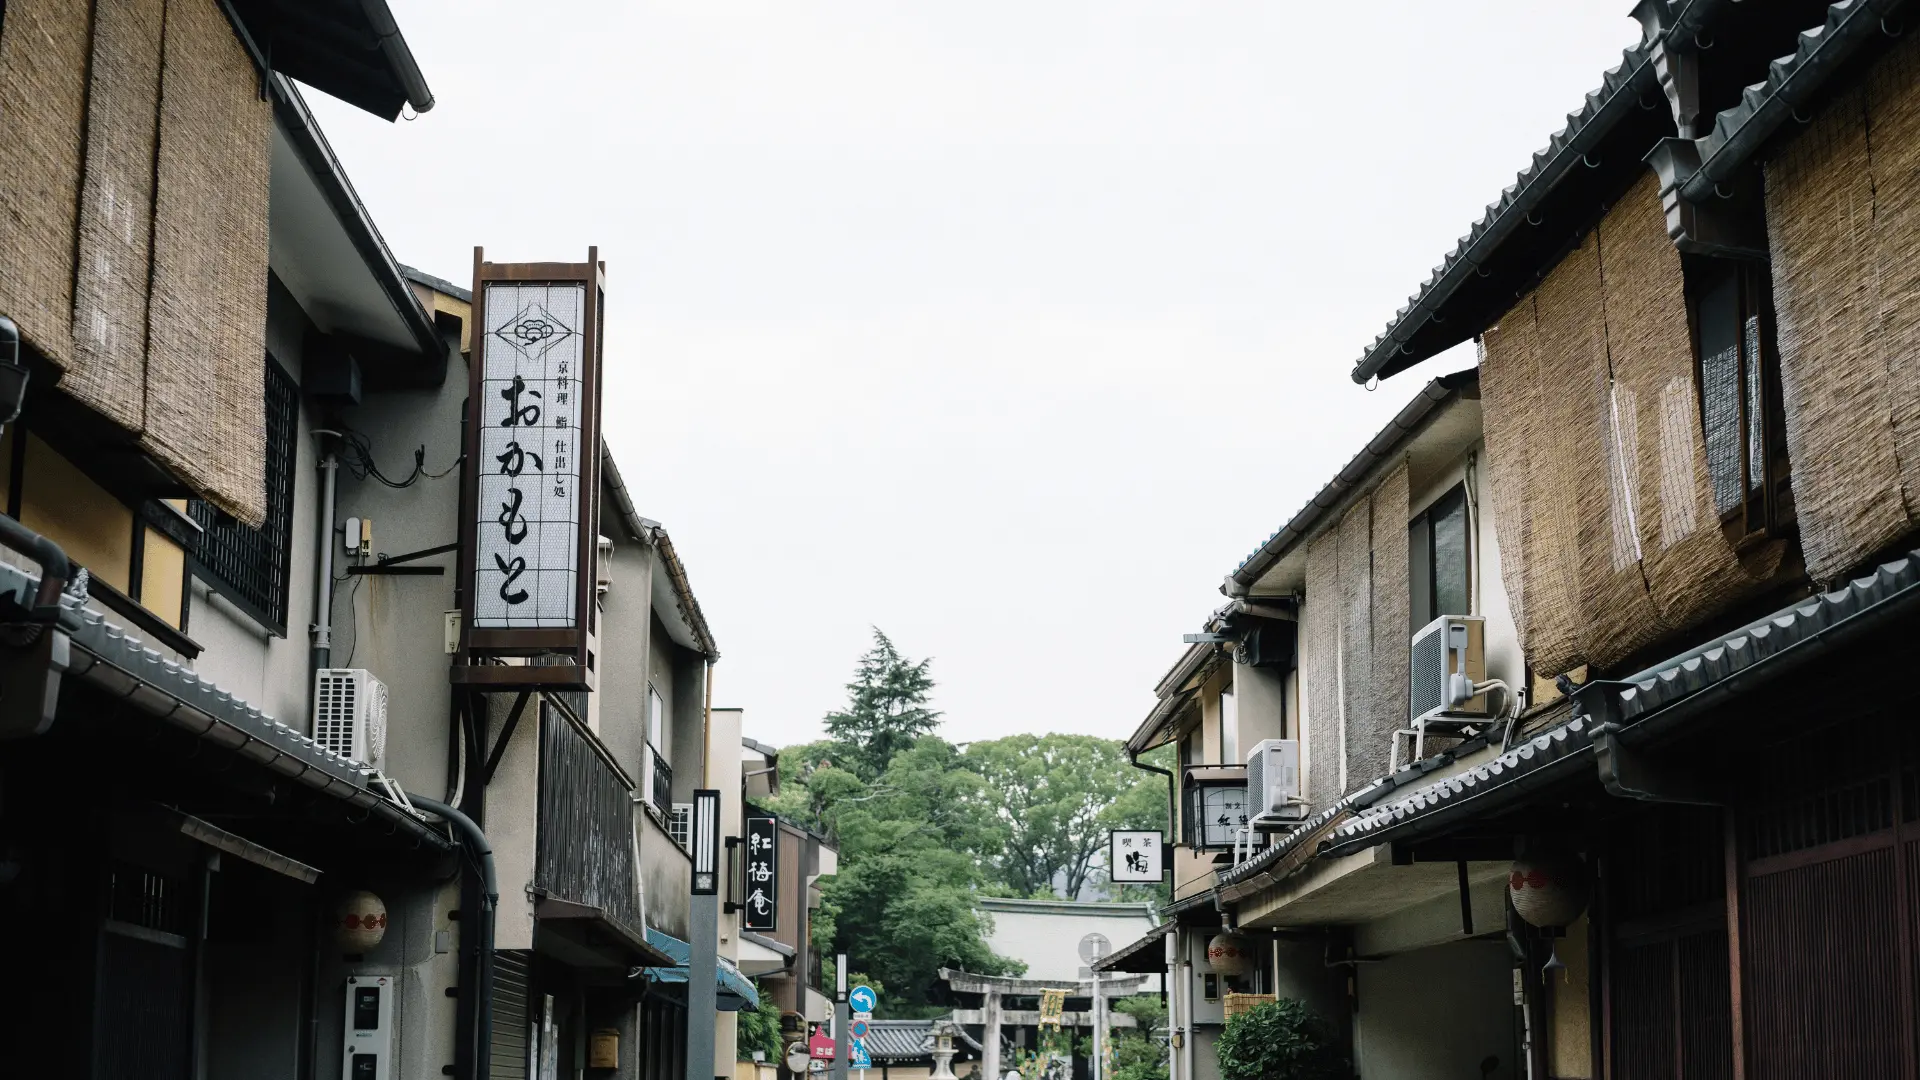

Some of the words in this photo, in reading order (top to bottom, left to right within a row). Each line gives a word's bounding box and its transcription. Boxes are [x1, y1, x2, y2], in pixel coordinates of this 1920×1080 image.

[556, 360, 569, 405] 京料理
[495, 376, 543, 604] おかもと
[553, 439, 567, 498] 仕出し処
[1122, 838, 1152, 848] 喫茶
[1125, 850, 1149, 874] 梅
[747, 832, 773, 915] 紅梅庵
[816, 1047, 833, 1056] たば
